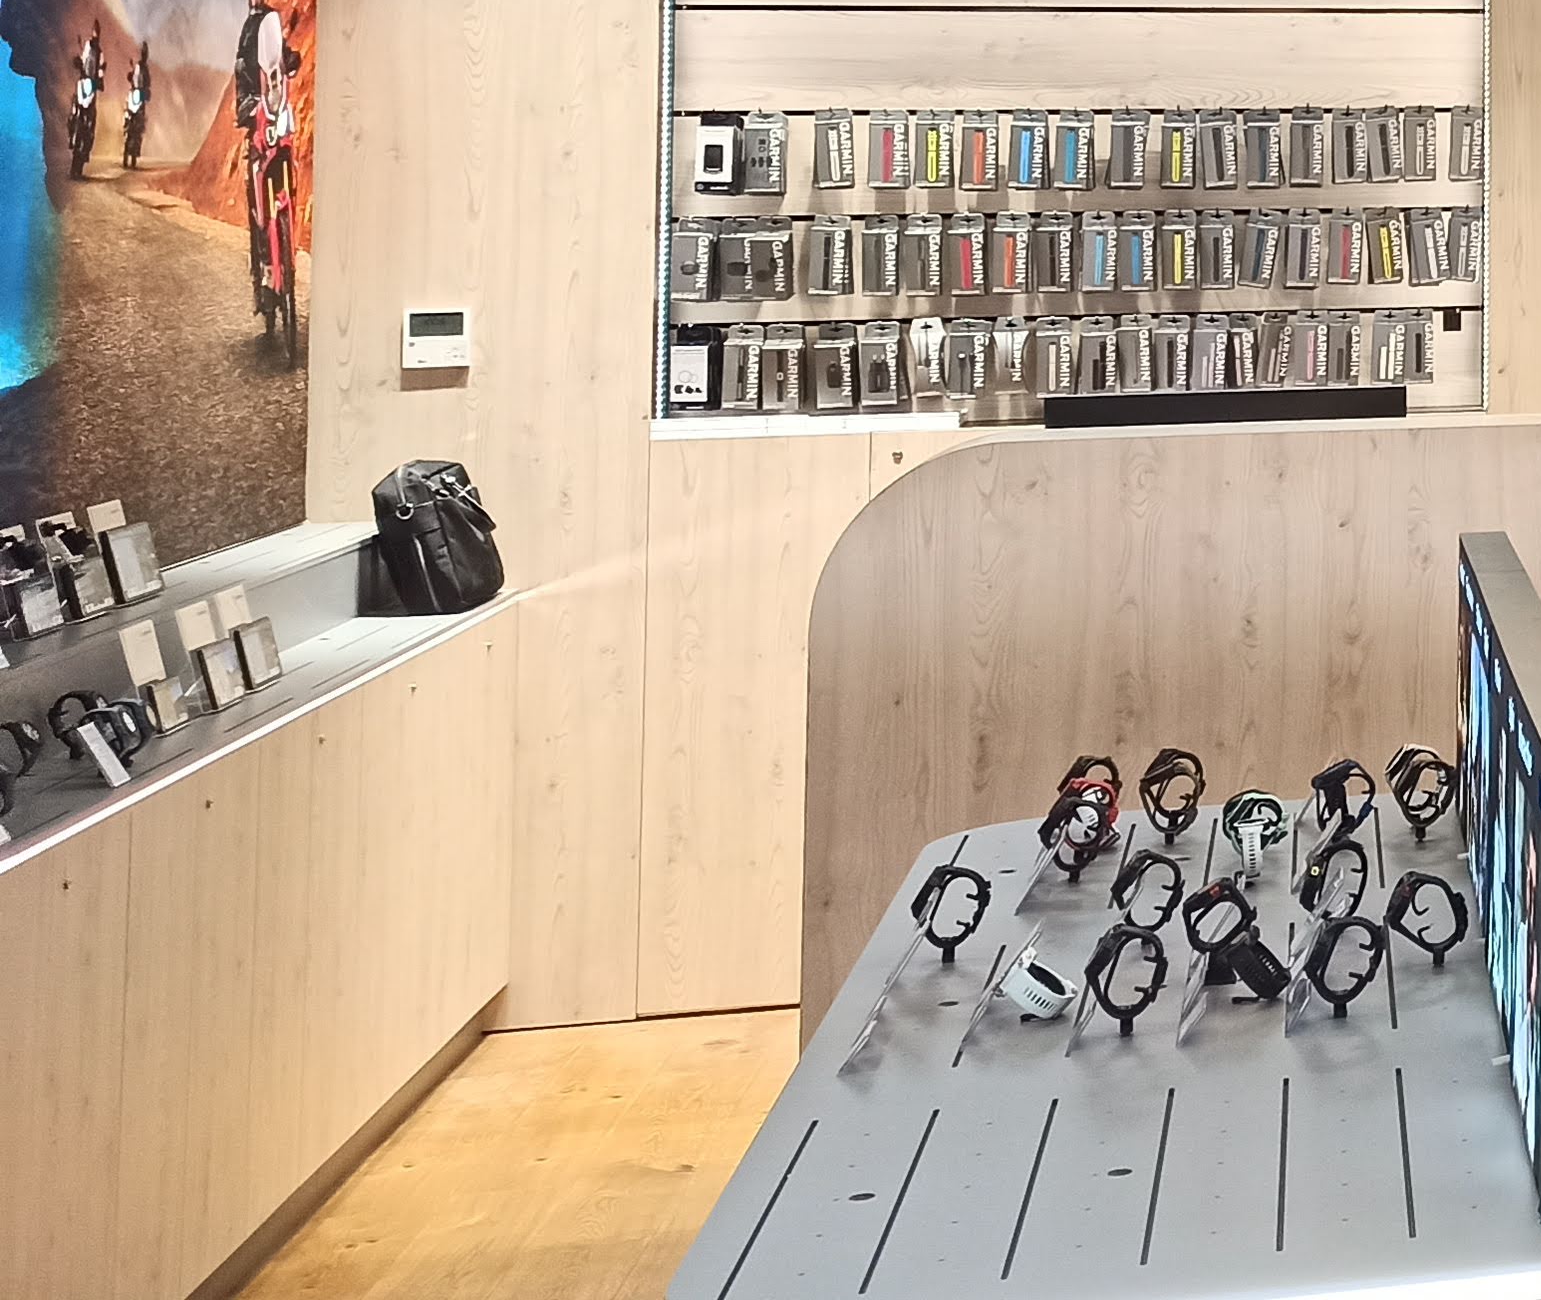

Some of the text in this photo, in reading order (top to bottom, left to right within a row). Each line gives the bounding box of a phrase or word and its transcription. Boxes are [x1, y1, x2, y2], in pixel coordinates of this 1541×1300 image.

[768, 129, 780, 182] GARMIN
[838, 122, 853, 175] GARMIN
[893, 124, 905, 176] GARMIN
[939, 125, 950, 176] GARMIN
[985, 128, 997, 179] GARMIN
[1031, 127, 1045, 178] GARMIN
[1077, 128, 1090, 179] GARMIN
[1133, 126, 1146, 177] GARMIN
[1183, 128, 1194, 178] GARMIN
[1223, 125, 1236, 175] GARMIN
[1269, 127, 1279, 177] GARMIN
[1312, 125, 1323, 174] GARMIN
[1353, 122, 1366, 173] GARMIN
[1388, 119, 1402, 169] GARMIN
[1426, 120, 1436, 170] GARMIN
[1471, 120, 1481, 170] GARMIN
[696, 237, 708, 288] GARMIN
[832, 231, 845, 284] GARMIN
[885, 234, 897, 286] GARMIN
[929, 234, 940, 285] GARMIN
[971, 233, 984, 283] GARMIN
[1015, 232, 1027, 283] GARMIN
[1059, 231, 1071, 282] GARMIN
[1105, 229, 1117, 281] GARMIN
[1142, 229, 1154, 281] GARMIN
[1184, 229, 1195, 280] GARMIN
[1222, 228, 1234, 278] GARMIN
[1262, 230, 1278, 278] GARMIN
[1309, 227, 1321, 277] GARMIN
[1350, 221, 1361, 272] GARMIN
[1388, 220, 1402, 269] GARMIN
[1434, 220, 1449, 269] GARMIN
[1468, 221, 1480, 270] GARMIN
[746, 345, 760, 399] GARMIN
[787, 349, 798, 398] GARMIN
[839, 346, 852, 396] GARMIN
[929, 336, 940, 382] ARMIN
[973, 335, 985, 388] GARMIN
[1059, 336, 1071, 386] GARMIN
[1105, 335, 1116, 386] GARMIN
[1138, 330, 1151, 381] GARMIN
[1176, 334, 1188, 384] GARMIN
[1215, 333, 1227, 384] GARMIN
[1242, 333, 1254, 383] GARMIN
[1279, 326, 1292, 377] GARMIN
[1316, 325, 1328, 376] GARMIN
[1350, 326, 1360, 376] GARMIN
[1395, 325, 1405, 374] GARMIN
[1424, 324, 1433, 373] GARMIN
